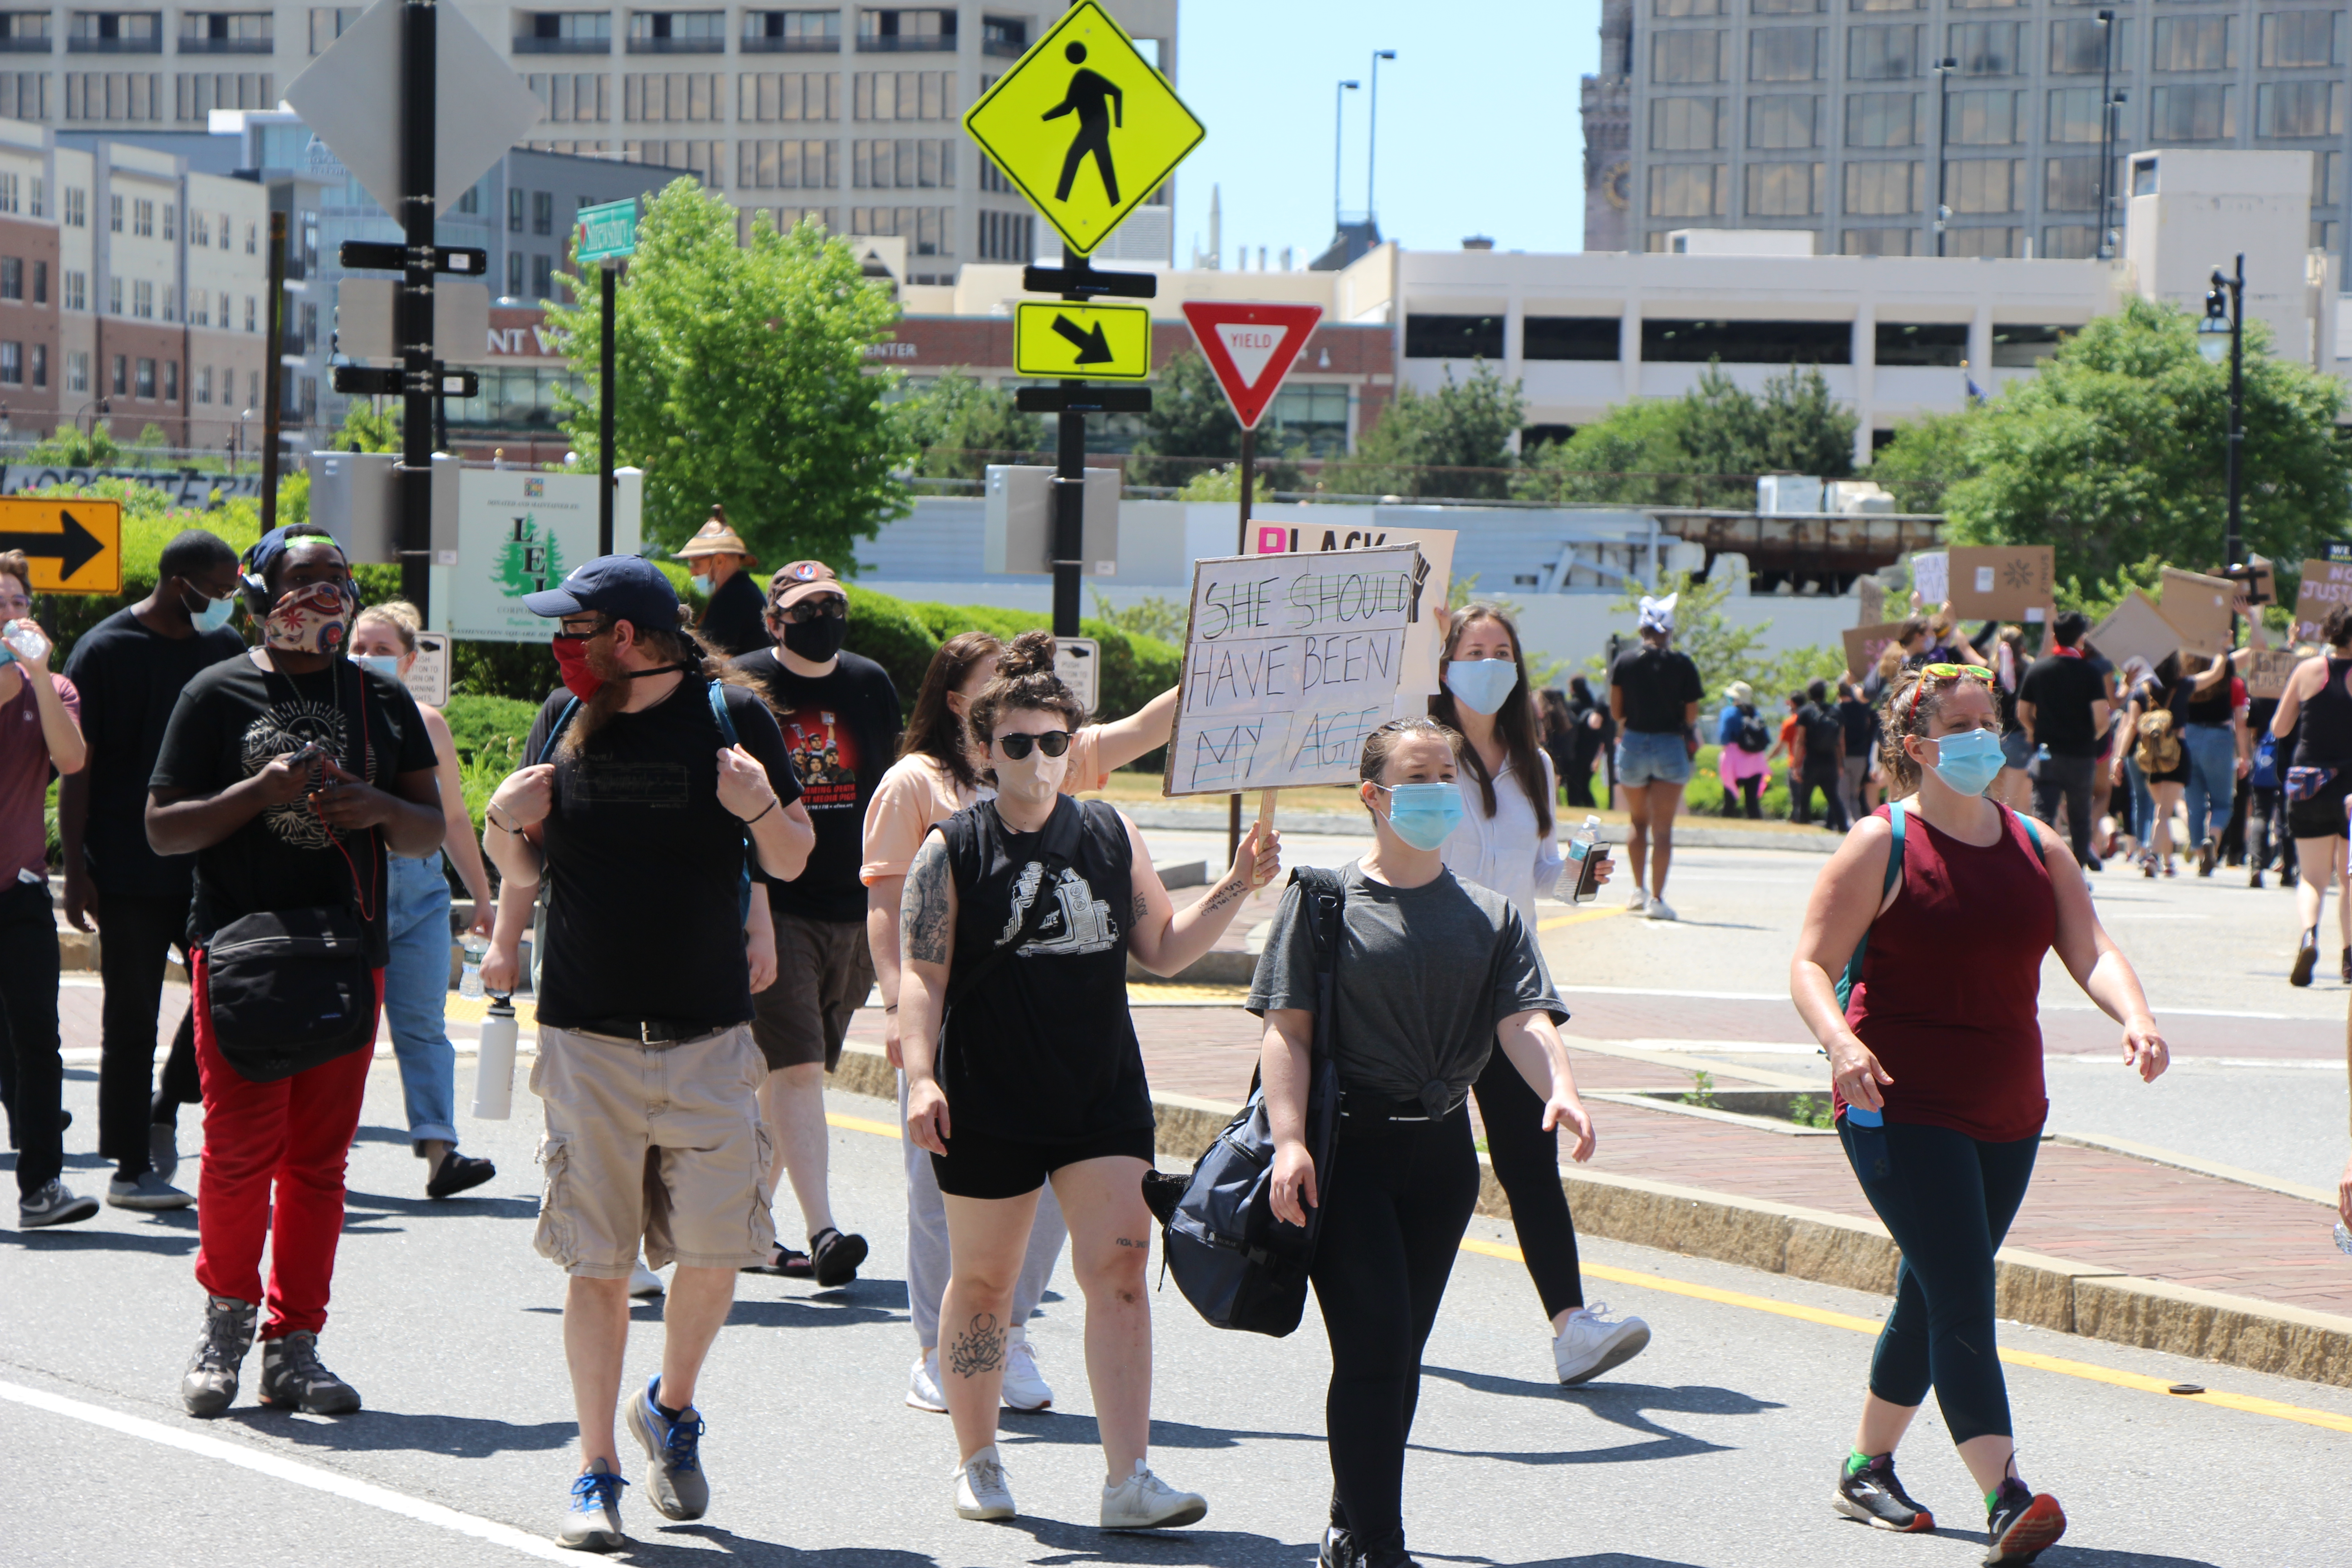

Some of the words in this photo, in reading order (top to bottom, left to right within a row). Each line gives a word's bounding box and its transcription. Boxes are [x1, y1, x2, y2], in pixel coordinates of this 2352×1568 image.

[1230, 333, 1272, 348] YIELD
[864, 342, 918, 359] ENTER
[2330, 544, 2350, 555] WE
[1202, 577, 1280, 640] SHE
[1289, 573, 1412, 630] SHOULD
[430, 665, 438, 673] TO
[1186, 644, 1289, 714] HAVE
[1301, 634, 1392, 696] BEEN
[1191, 717, 1264, 790] MY
[1289, 706, 1381, 773] AGE
[804, 785, 832, 794] AMING
[833, 783, 856, 793] DEATH
[812, 794, 838, 803] MEDIA
[1134, 892, 1148, 920] LOOK
[1116, 1238, 1132, 1248] YOU
